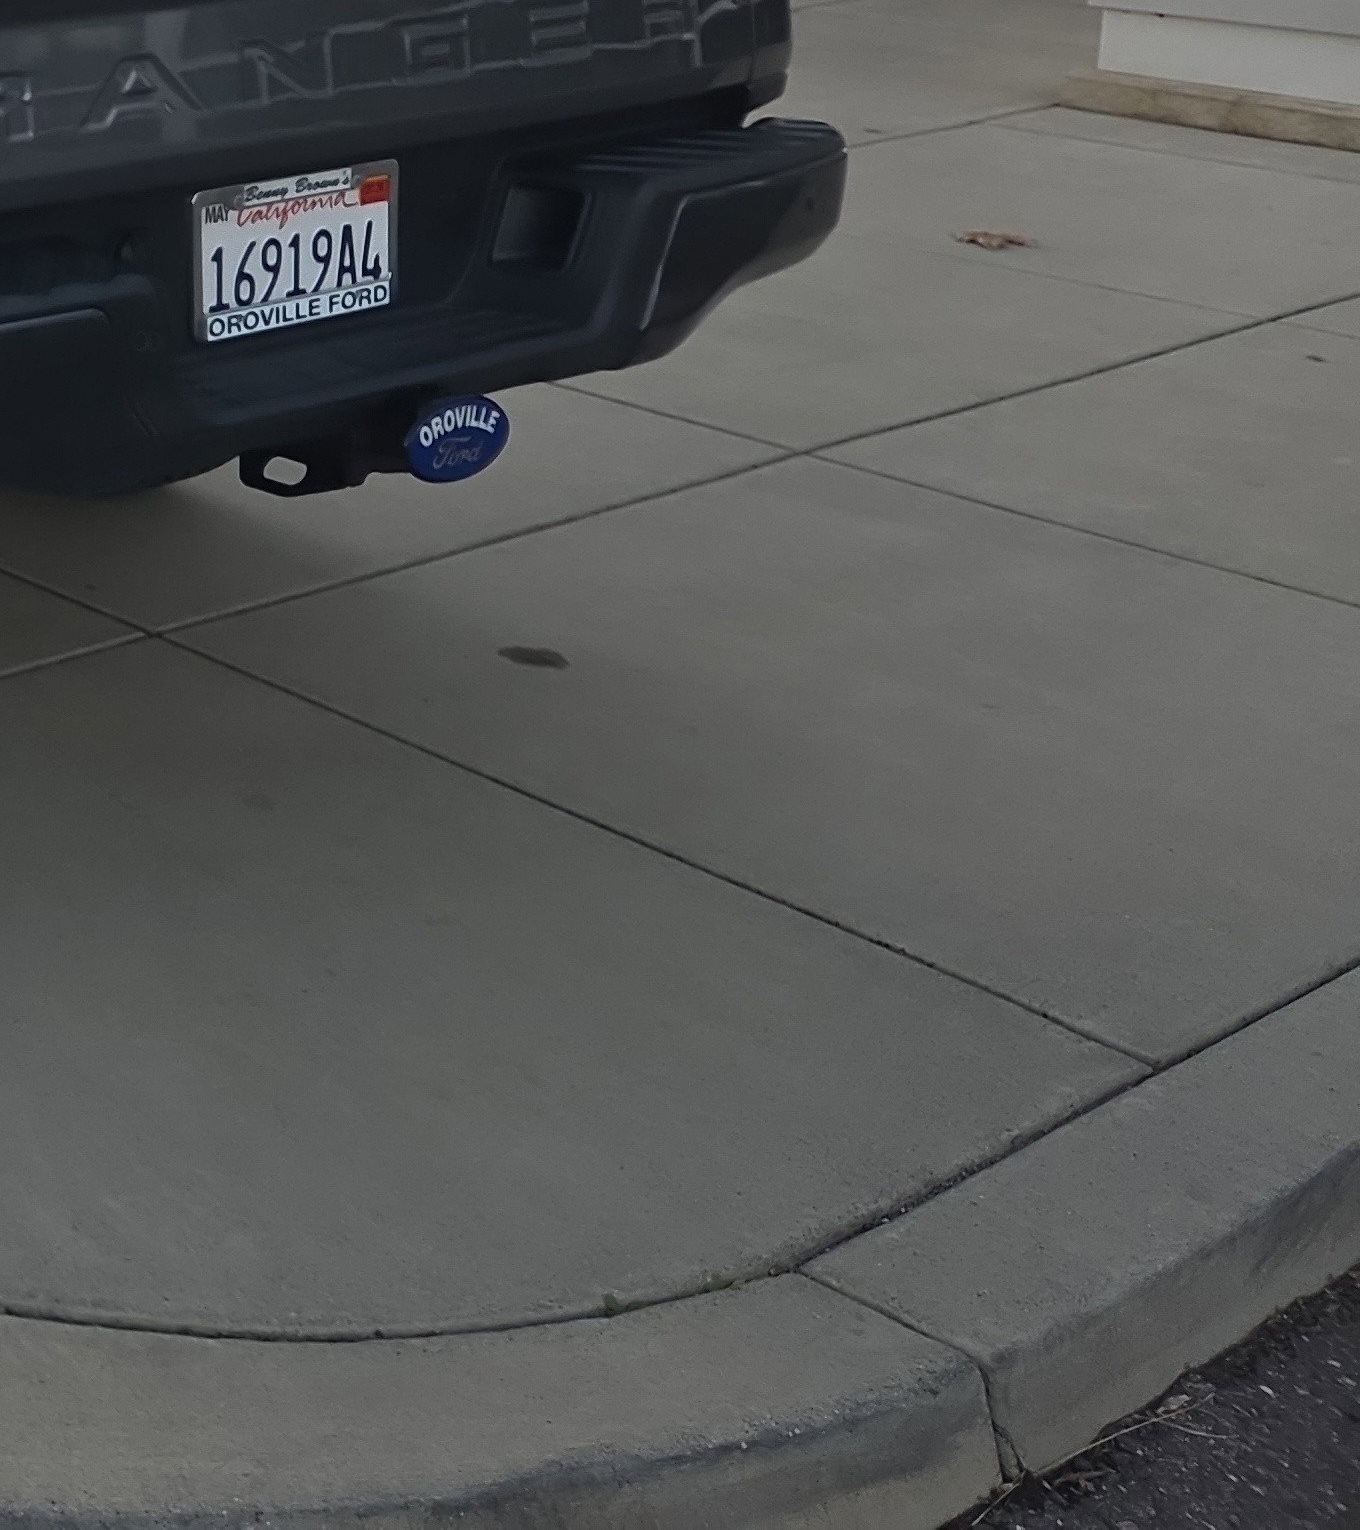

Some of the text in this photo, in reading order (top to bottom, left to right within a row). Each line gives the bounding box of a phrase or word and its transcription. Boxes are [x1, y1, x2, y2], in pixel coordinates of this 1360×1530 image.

[204, 205, 230, 225] MAY
[236, 190, 358, 230] California
[208, 219, 383, 314] 16919A4
[208, 283, 388, 337] OROVILLE FORD
[418, 404, 501, 449] OROVILLE
